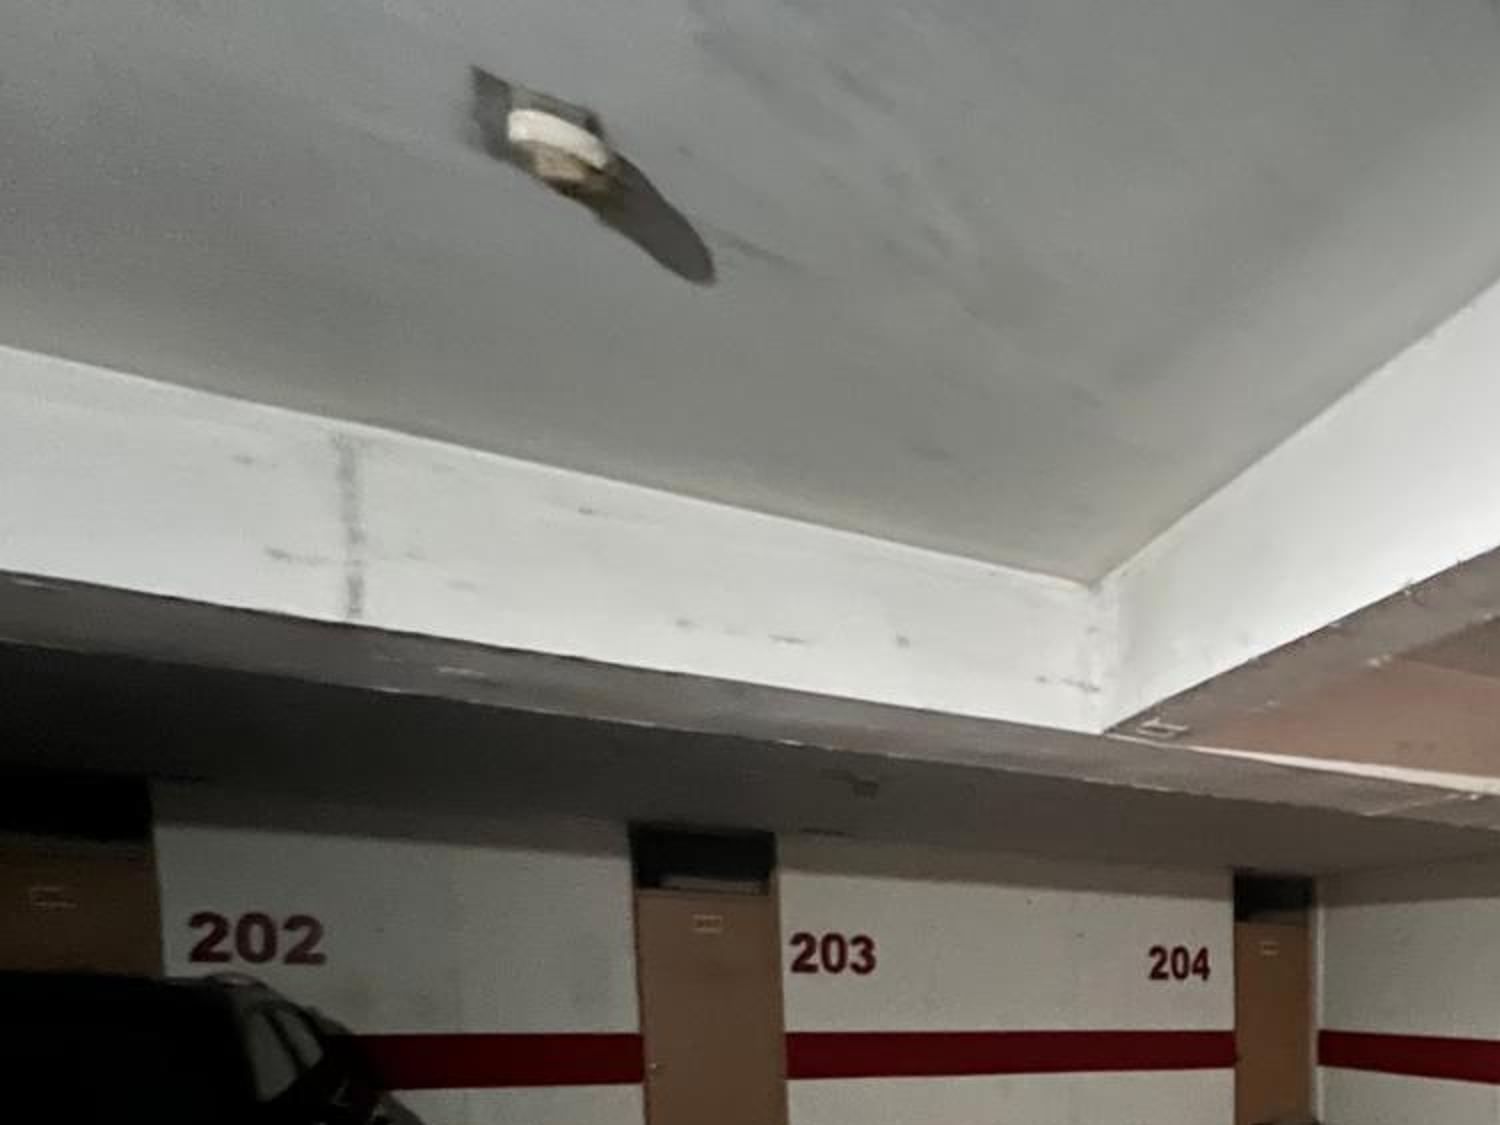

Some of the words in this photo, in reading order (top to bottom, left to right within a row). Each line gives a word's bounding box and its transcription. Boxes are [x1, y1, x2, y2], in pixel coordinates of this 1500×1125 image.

[189, 911, 326, 965] 202
[789, 932, 877, 975] 203
[1148, 945, 1211, 981] 204
